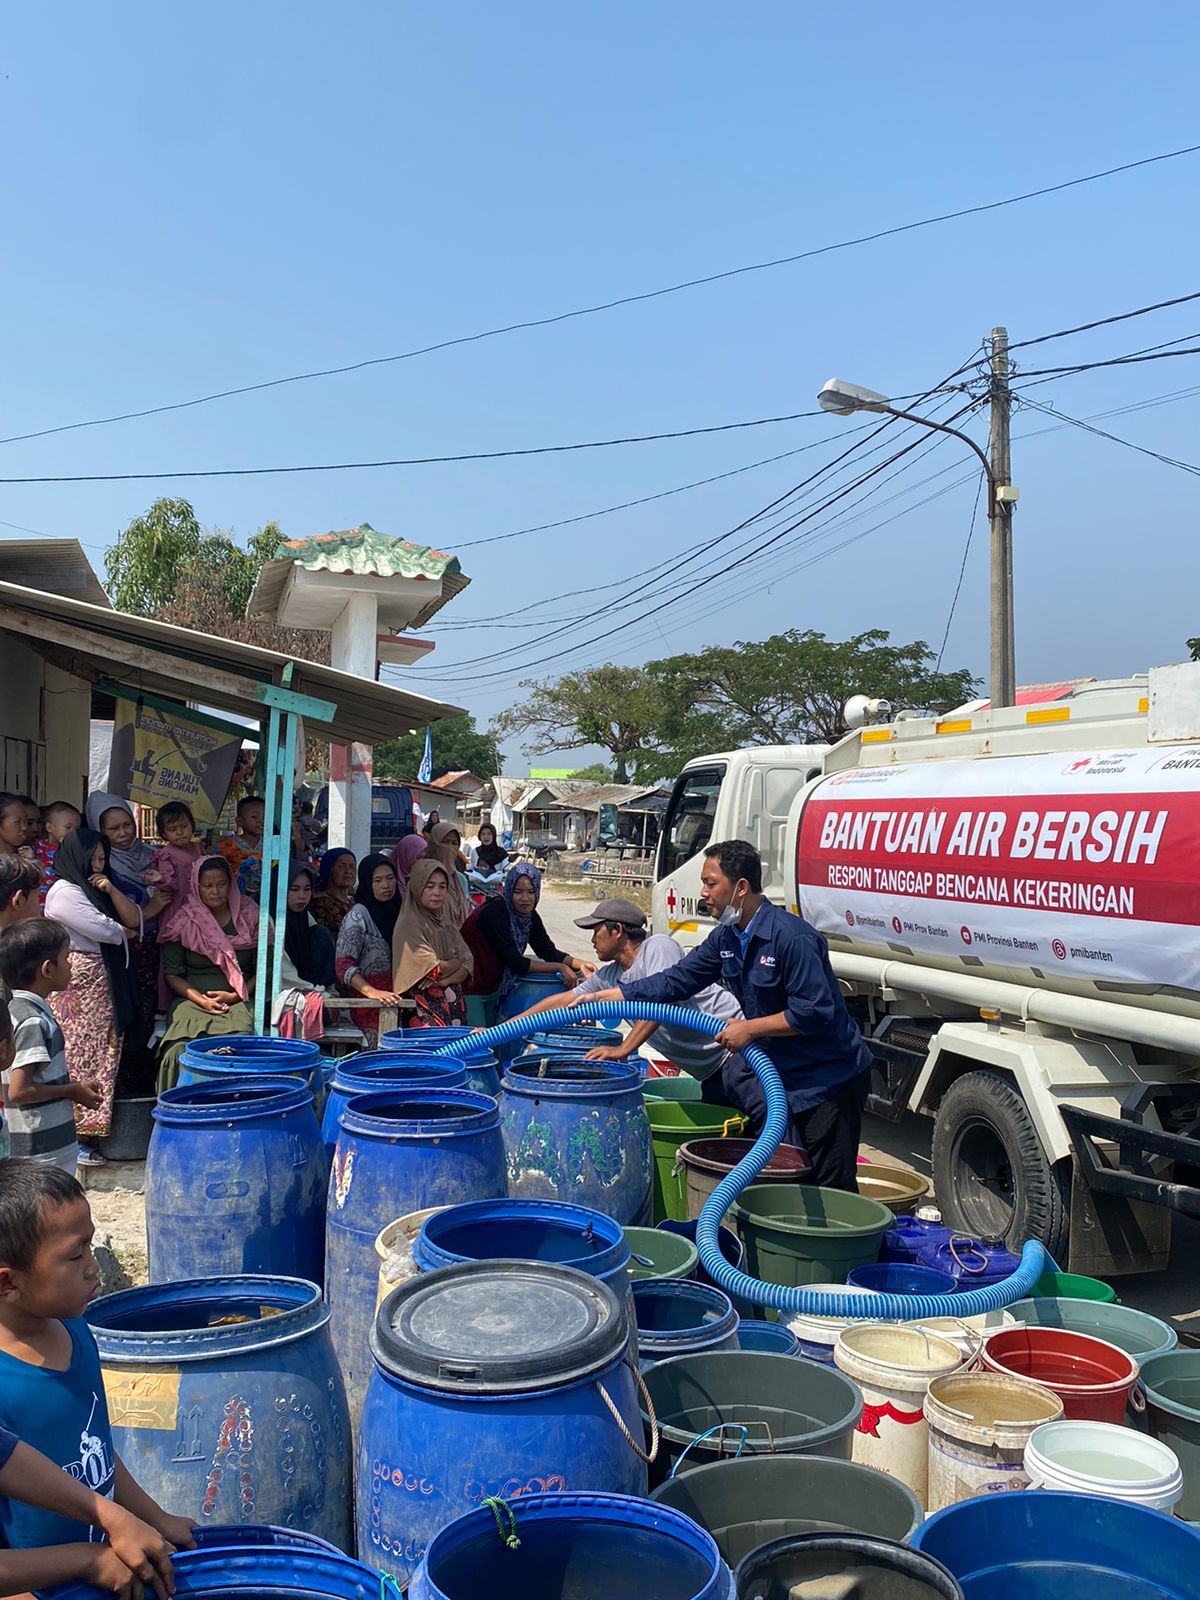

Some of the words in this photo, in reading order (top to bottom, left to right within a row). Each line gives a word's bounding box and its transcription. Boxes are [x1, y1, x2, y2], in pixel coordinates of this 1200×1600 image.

[819, 811, 947, 855] BANTUAN
[947, 811, 1007, 858] AIR
[1010, 811, 1168, 865] BERSIH
[828, 865, 871, 889] RESPON
[874, 869, 933, 896] TANGGAP
[936, 874, 1009, 903] BENCANA
[1013, 879, 1135, 915] KEKERINGAN
[856, 915, 886, 928] @pmibanten
[904, 922, 914, 930] PMI
[915, 924, 927, 933] Prov
[928, 925, 949, 937] Banten
[974, 932, 986, 943] PMI
[987, 933, 1013, 948] Provinsi
[1013, 937, 1039, 951] Banten
[1070, 947, 1114, 962] pmibanten
